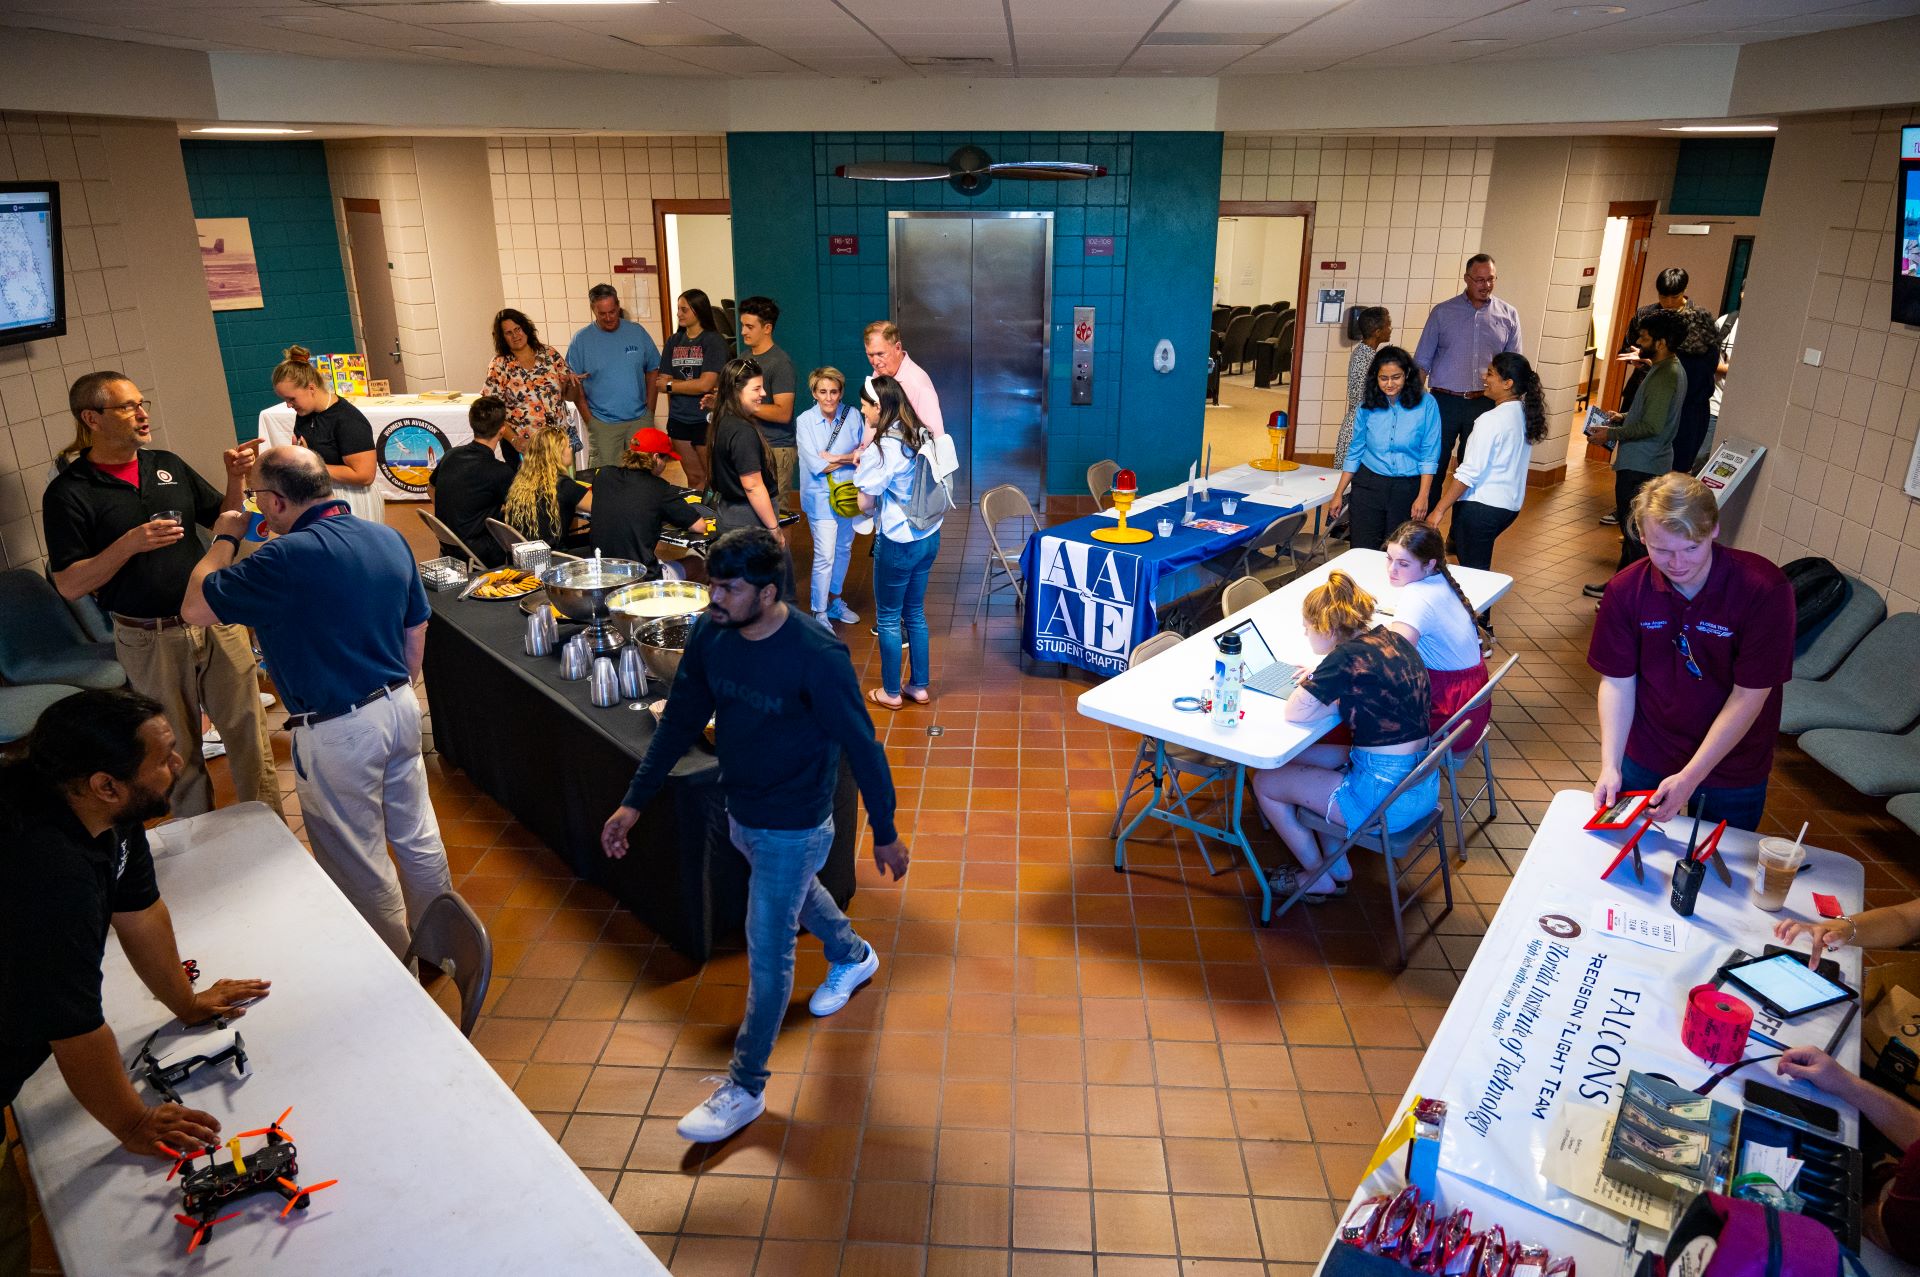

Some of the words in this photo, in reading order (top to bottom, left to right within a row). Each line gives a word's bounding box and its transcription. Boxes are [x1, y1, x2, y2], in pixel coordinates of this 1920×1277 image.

[384, 421, 403, 436] WOMEN
[411, 419, 437, 434] AVIATION
[381, 463, 393, 479] SPACE
[391, 477, 407, 489] COAST
[1036, 639, 1084, 659] STUDENT
[1526, 939, 1544, 957] High
[1513, 966, 1529, 984] with
[1535, 941, 1570, 986] Florida
[1491, 1008, 1511, 1030] Touch
[1511, 985, 1551, 1038] Institute
[1499, 1037, 1526, 1064] of
[1550, 1021, 1582, 1075] FLIGHT
[1579, 987, 1641, 1105] FALCONS
[1464, 1056, 1522, 1138] Technology
[1531, 1079, 1562, 1120] TEAM
